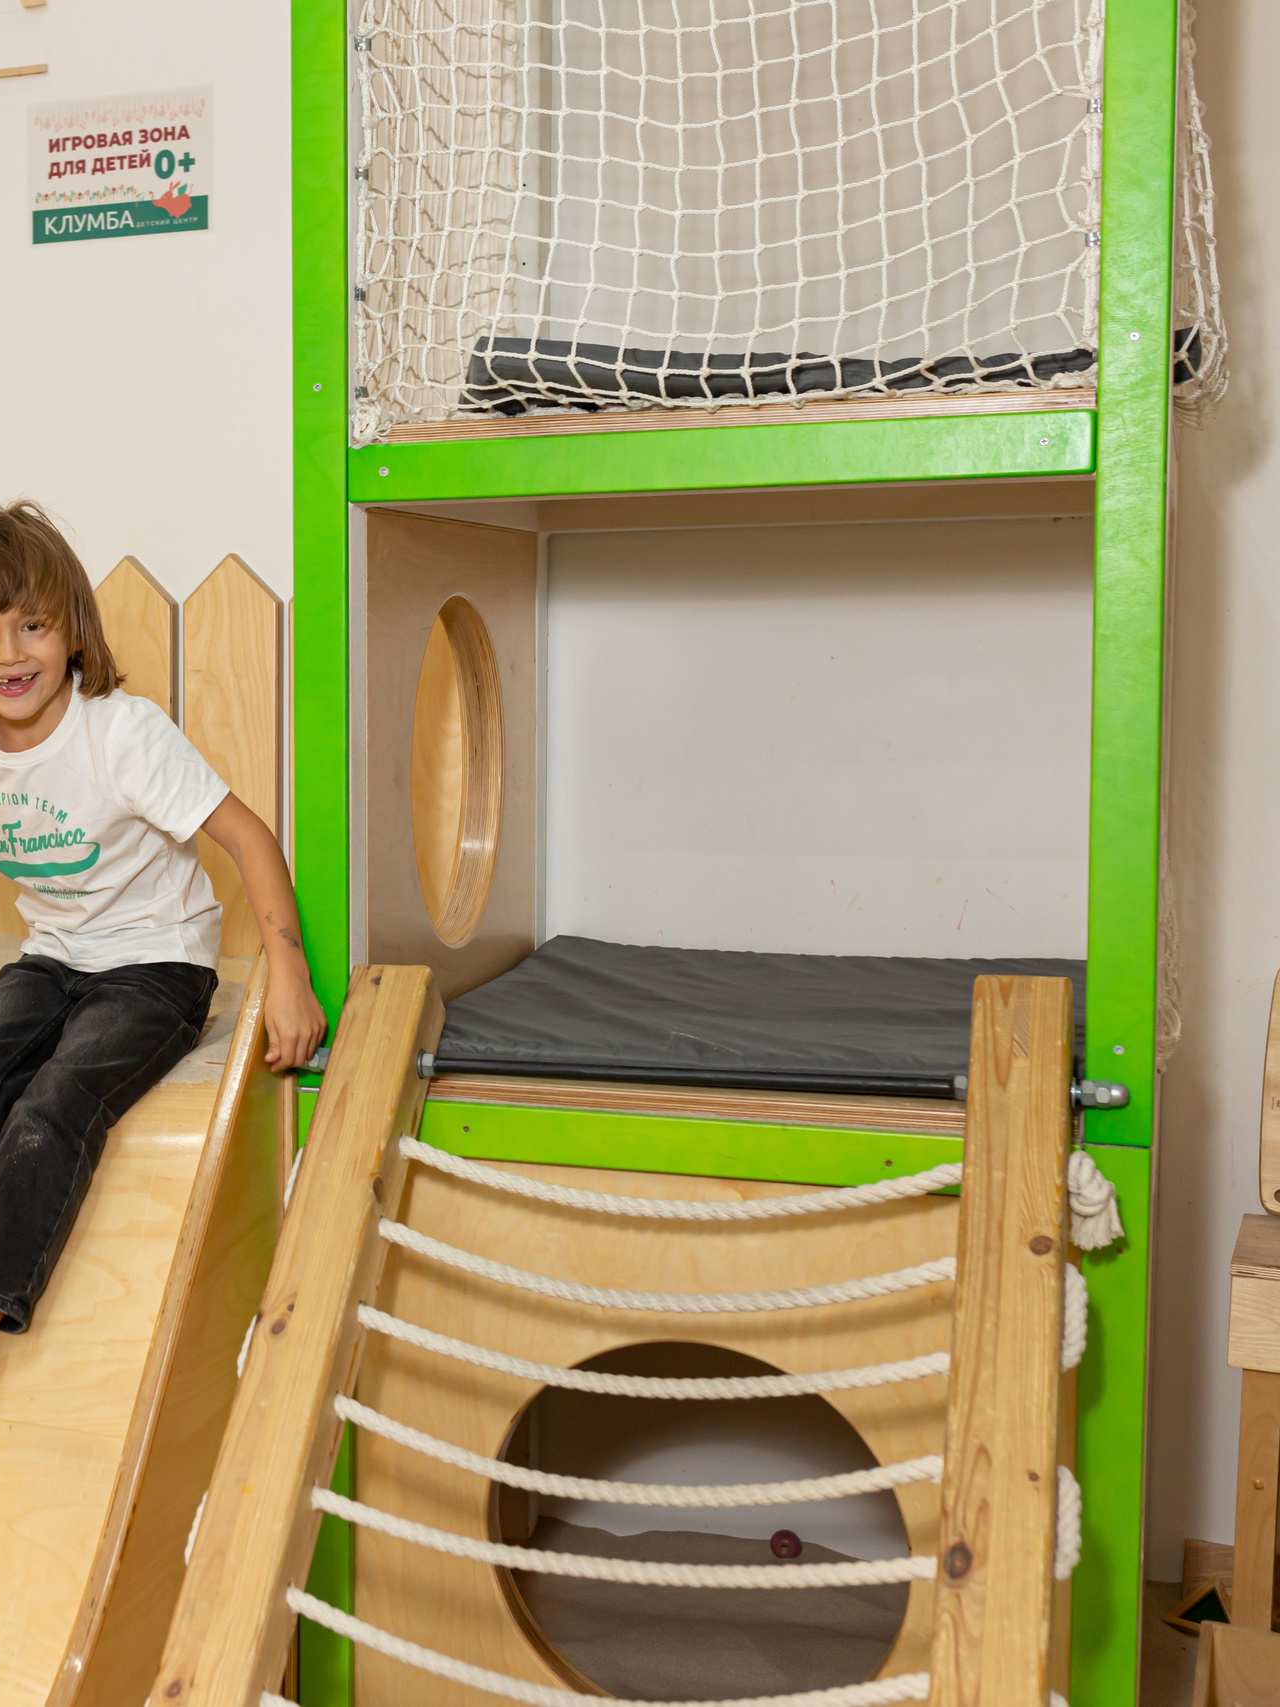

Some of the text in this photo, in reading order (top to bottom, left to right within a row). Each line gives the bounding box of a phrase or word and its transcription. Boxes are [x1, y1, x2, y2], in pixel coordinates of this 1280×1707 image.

[48, 124, 191, 153] ИГРОВАЯ ЗОНА
[48, 149, 151, 180] ДЛЯ ДЕТЕЙ
[154, 149, 196, 180] 0+
[44, 210, 135, 236] КЛУМБА
[35, 796, 68, 824] TEAM
